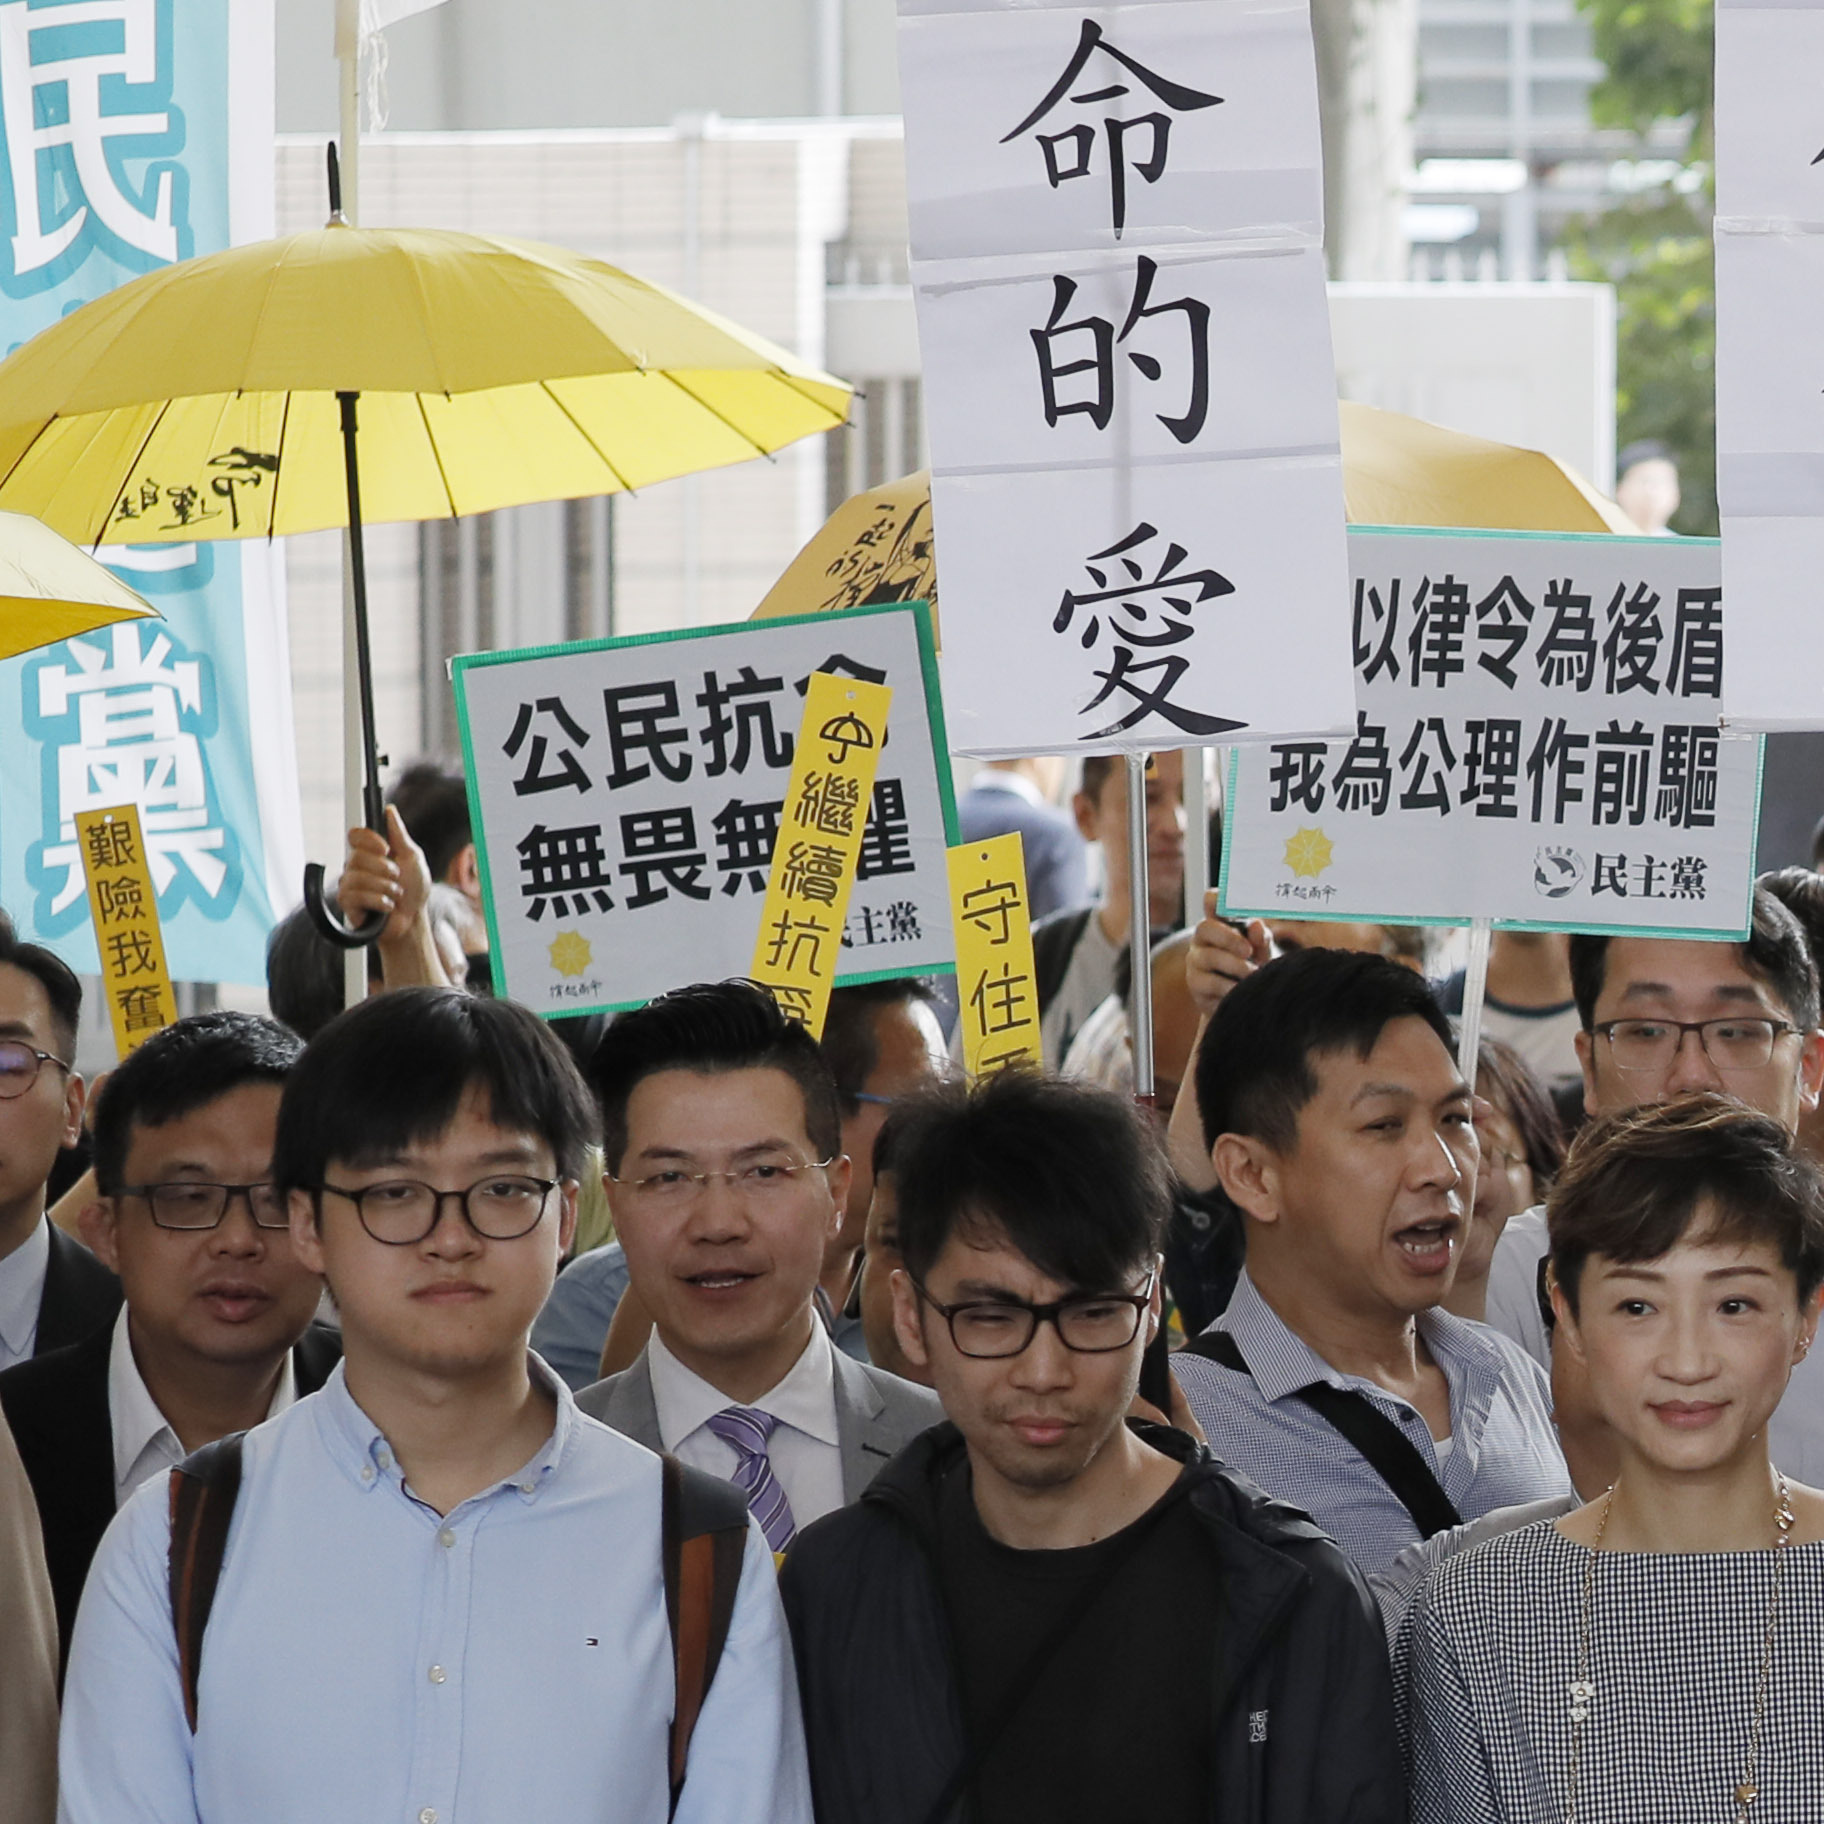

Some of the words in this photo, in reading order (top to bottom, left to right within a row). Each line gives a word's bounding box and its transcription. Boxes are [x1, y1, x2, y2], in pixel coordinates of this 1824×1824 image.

[1000, 18, 1248, 740] 命的愛
[1353, 574, 1723, 699] 以律令為後盾
[86, 820, 166, 1050] 艱險我奮
[839, 901, 923, 949] 主黨
[1591, 853, 1708, 901] 民主黨
[961, 879, 1035, 1068] 守住
